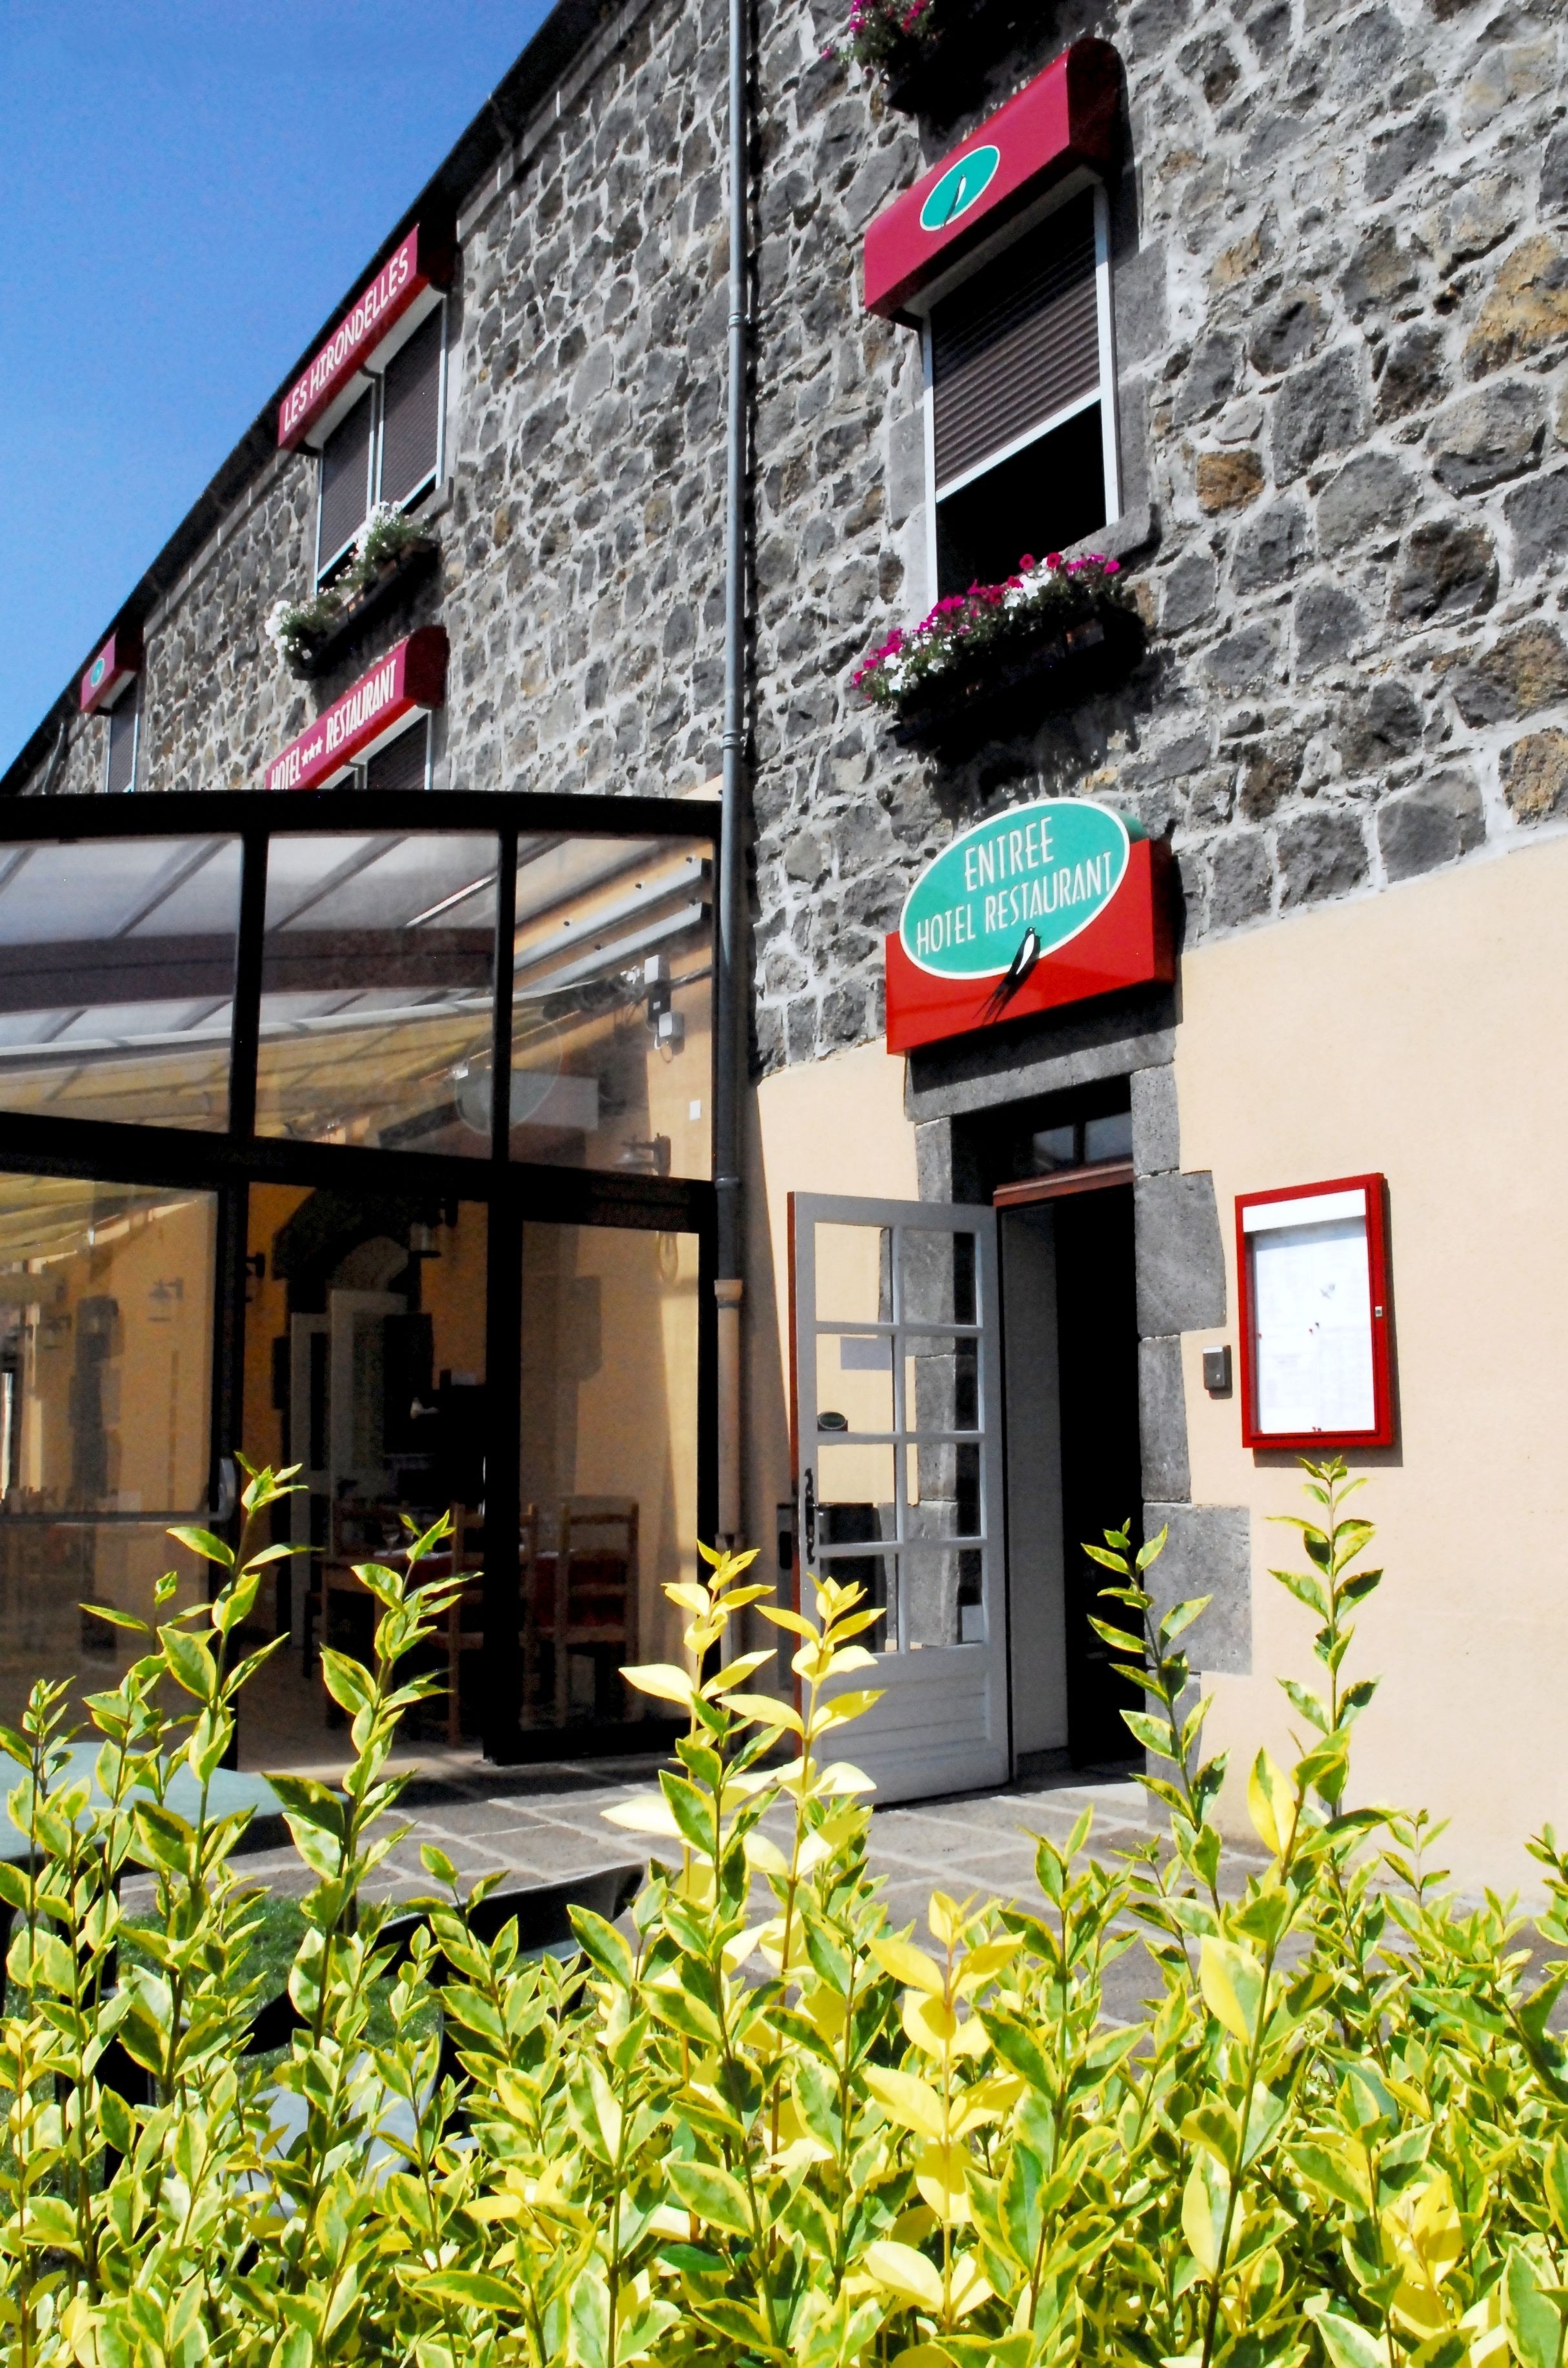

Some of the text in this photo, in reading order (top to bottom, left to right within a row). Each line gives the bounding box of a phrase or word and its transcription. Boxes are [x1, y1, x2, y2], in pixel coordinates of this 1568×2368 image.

[284, 247, 408, 432] LES HIRONDELLES
[271, 659, 396, 789] HOTEL RESTAURANT
[916, 851, 1111, 956] HOTEL RESTAURANT
[964, 816, 1054, 892] ENTREE
